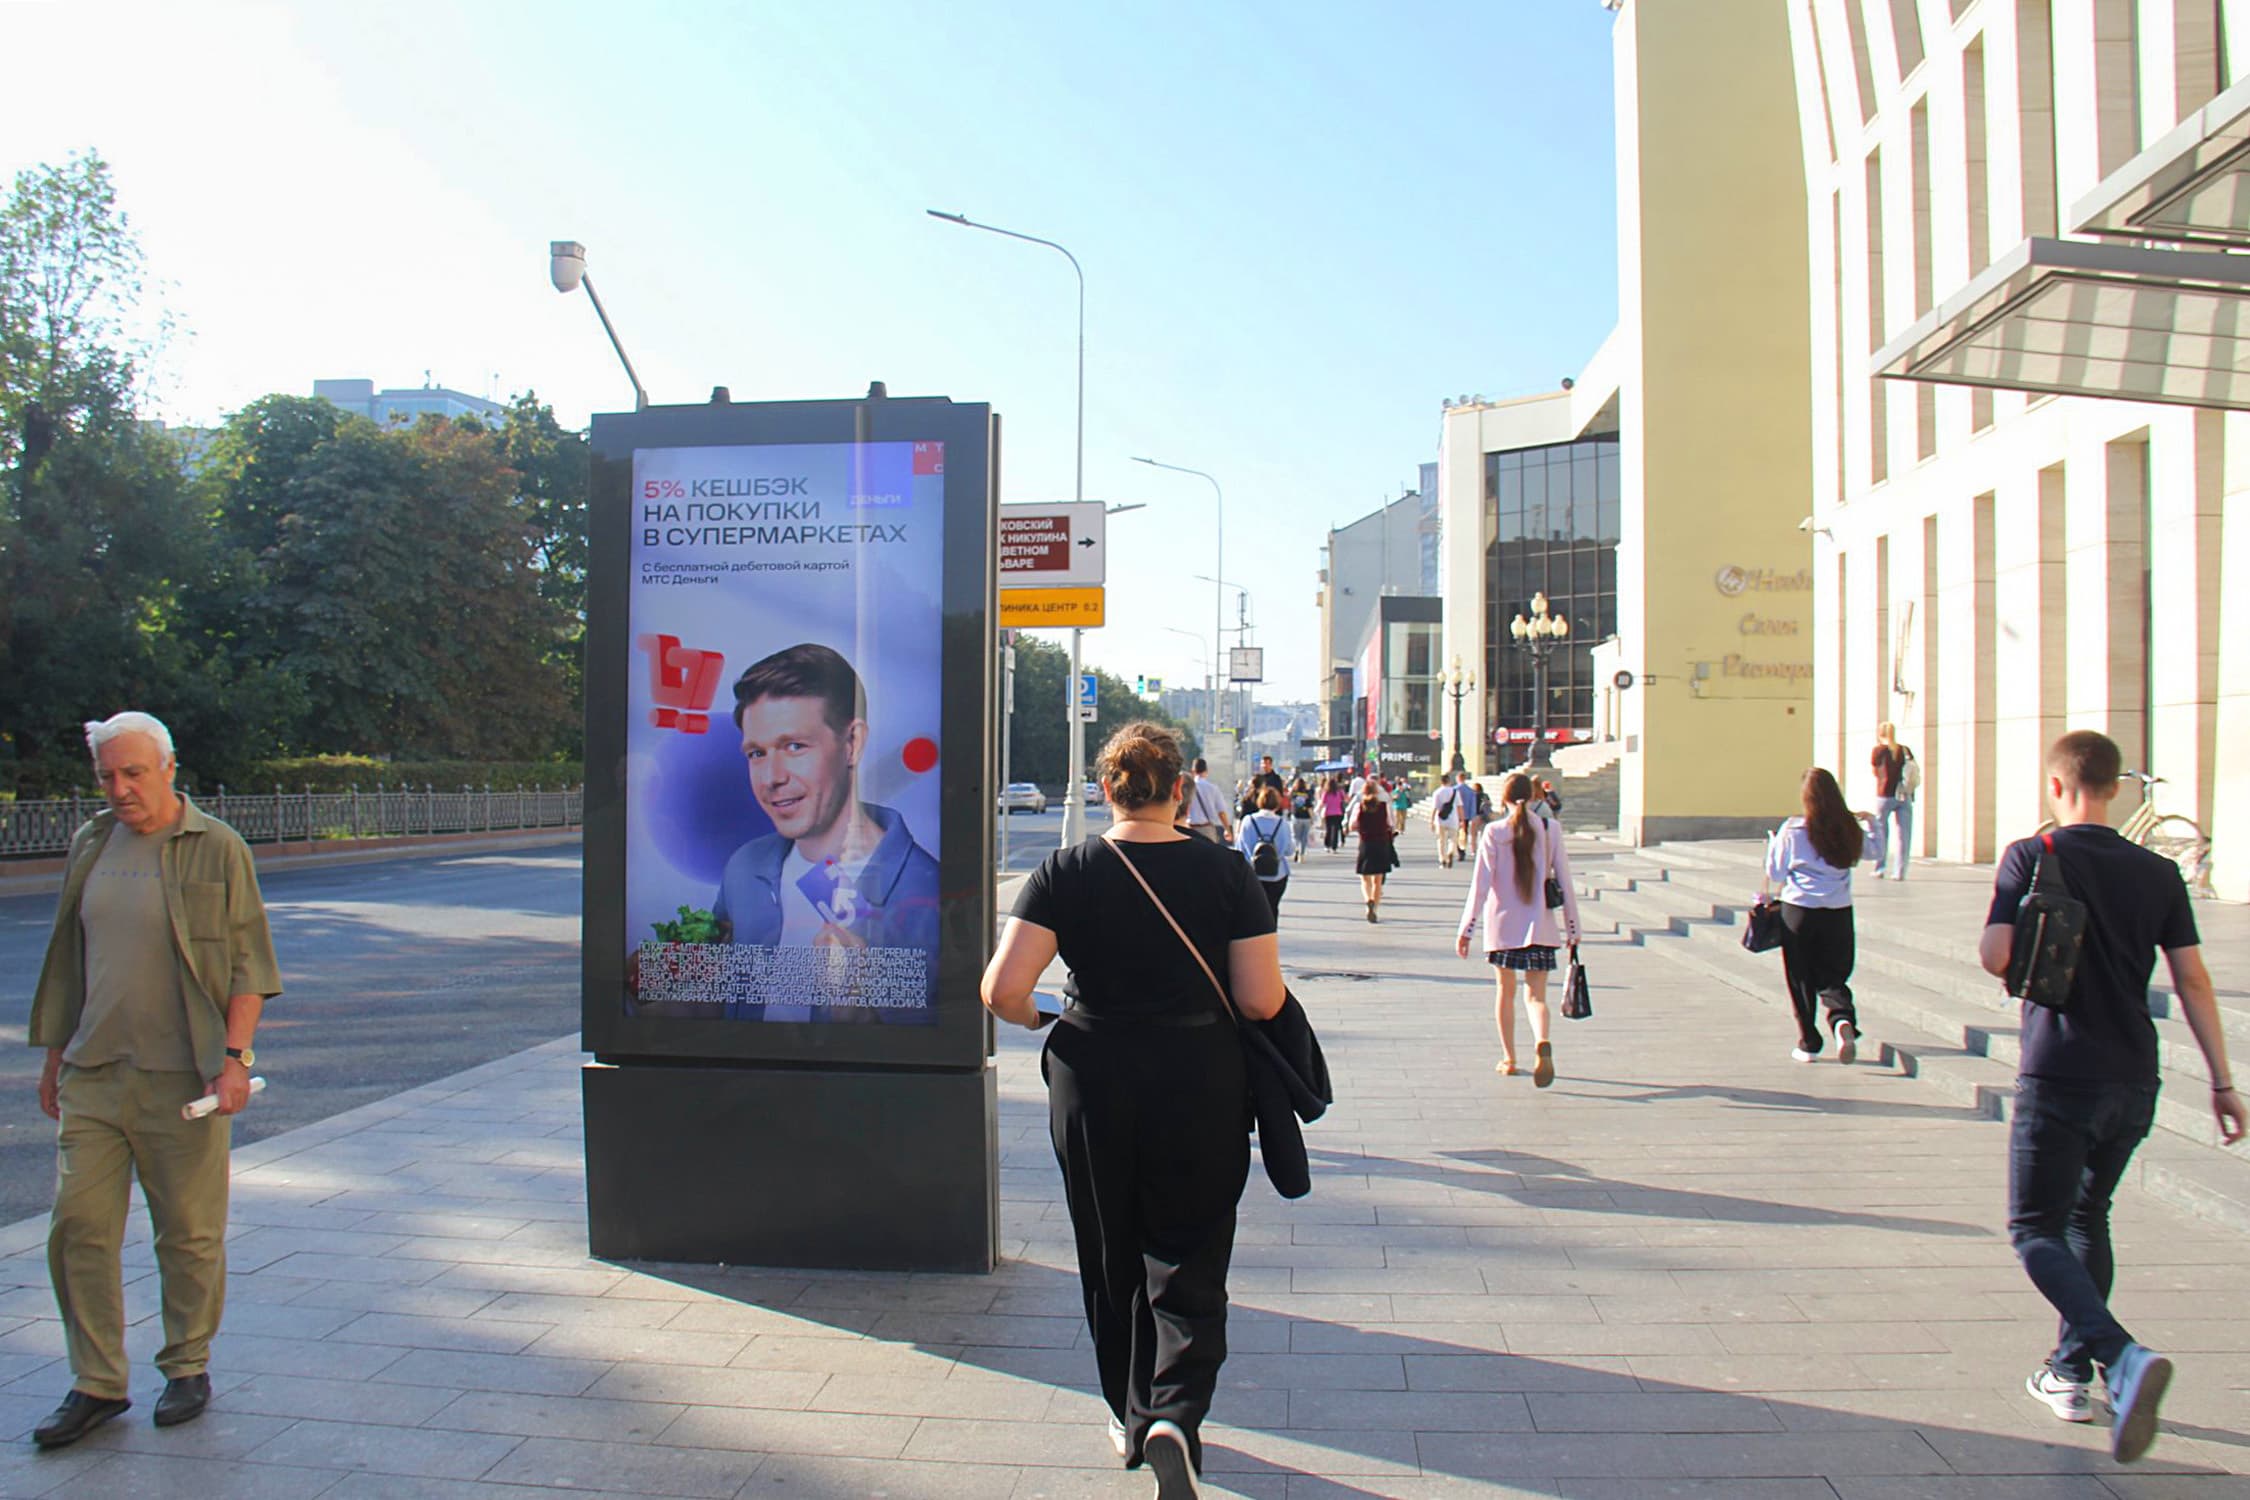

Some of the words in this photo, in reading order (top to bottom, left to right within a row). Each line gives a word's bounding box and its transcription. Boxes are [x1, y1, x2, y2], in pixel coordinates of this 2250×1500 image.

[644, 480, 686, 499] 5%
[692, 477, 808, 497] КЕШБЭК
[644, 504, 681, 522] НА
[687, 501, 820, 521] ПОКУПКИ
[644, 529, 660, 546] В
[666, 524, 907, 546] СУПЕРМАРКЕТАХ
[1008, 531, 1068, 543] НИКУЛИНА
[1000, 545, 1049, 557] ВЕТНОМ
[642, 563, 652, 573] С
[654, 561, 728, 572] бесплатной
[731, 560, 801, 572] дебетовой
[803, 559, 850, 573] картой
[642, 575, 669, 584] МТС
[672, 574, 719, 586] Деньги
[1042, 602, 1078, 613] ЦЕНТР
[1381, 751, 1414, 762] PRIME
